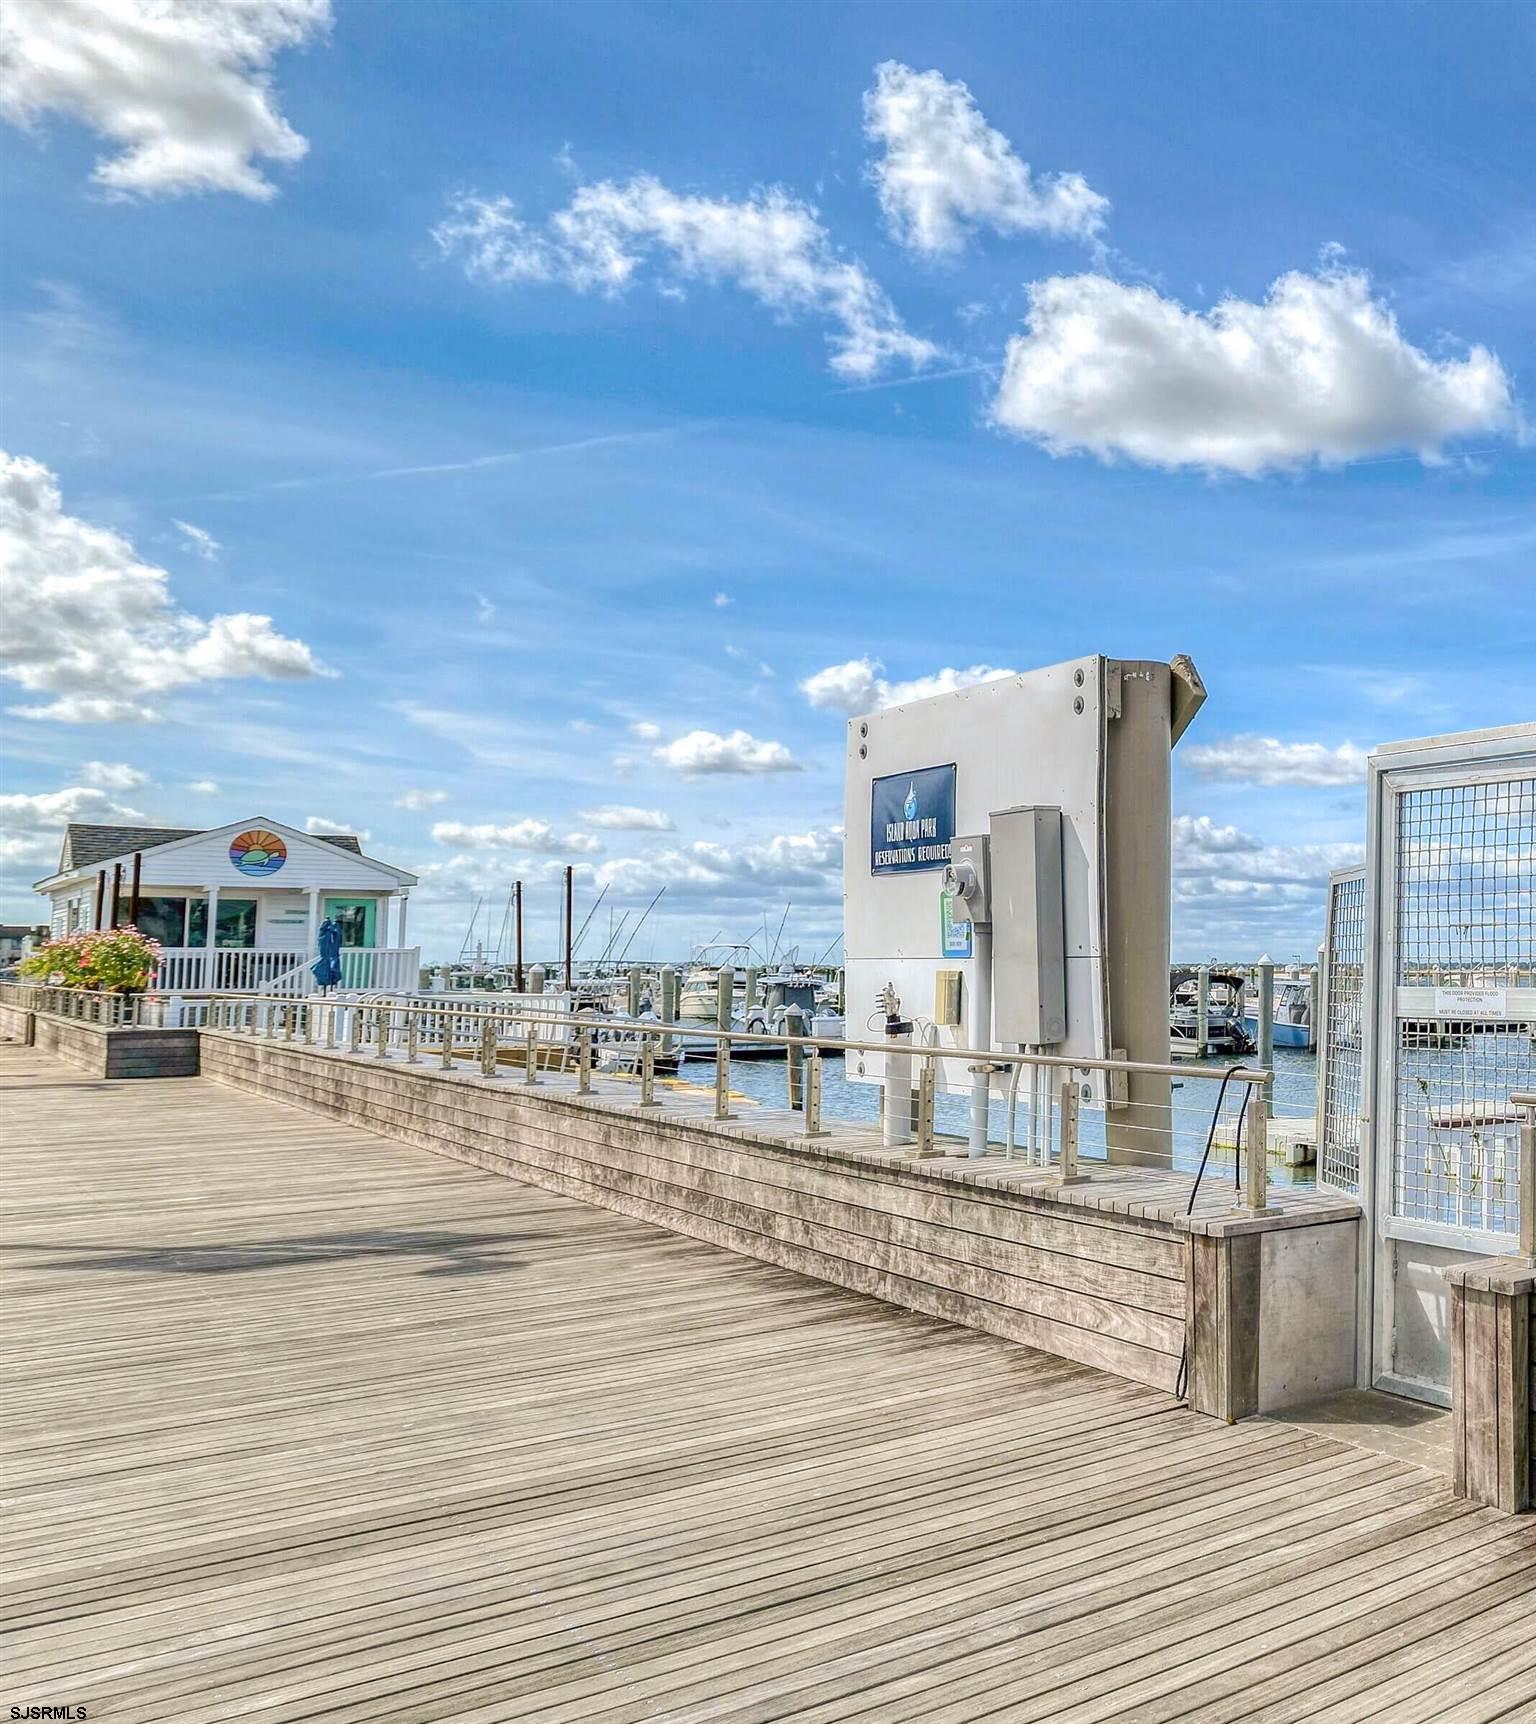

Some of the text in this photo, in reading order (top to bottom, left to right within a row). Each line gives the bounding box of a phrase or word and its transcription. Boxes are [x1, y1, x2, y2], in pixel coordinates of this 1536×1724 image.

[886, 817, 937, 843] ISLAND AQUA PARK
[875, 847, 915, 866] RESERVATIONS
